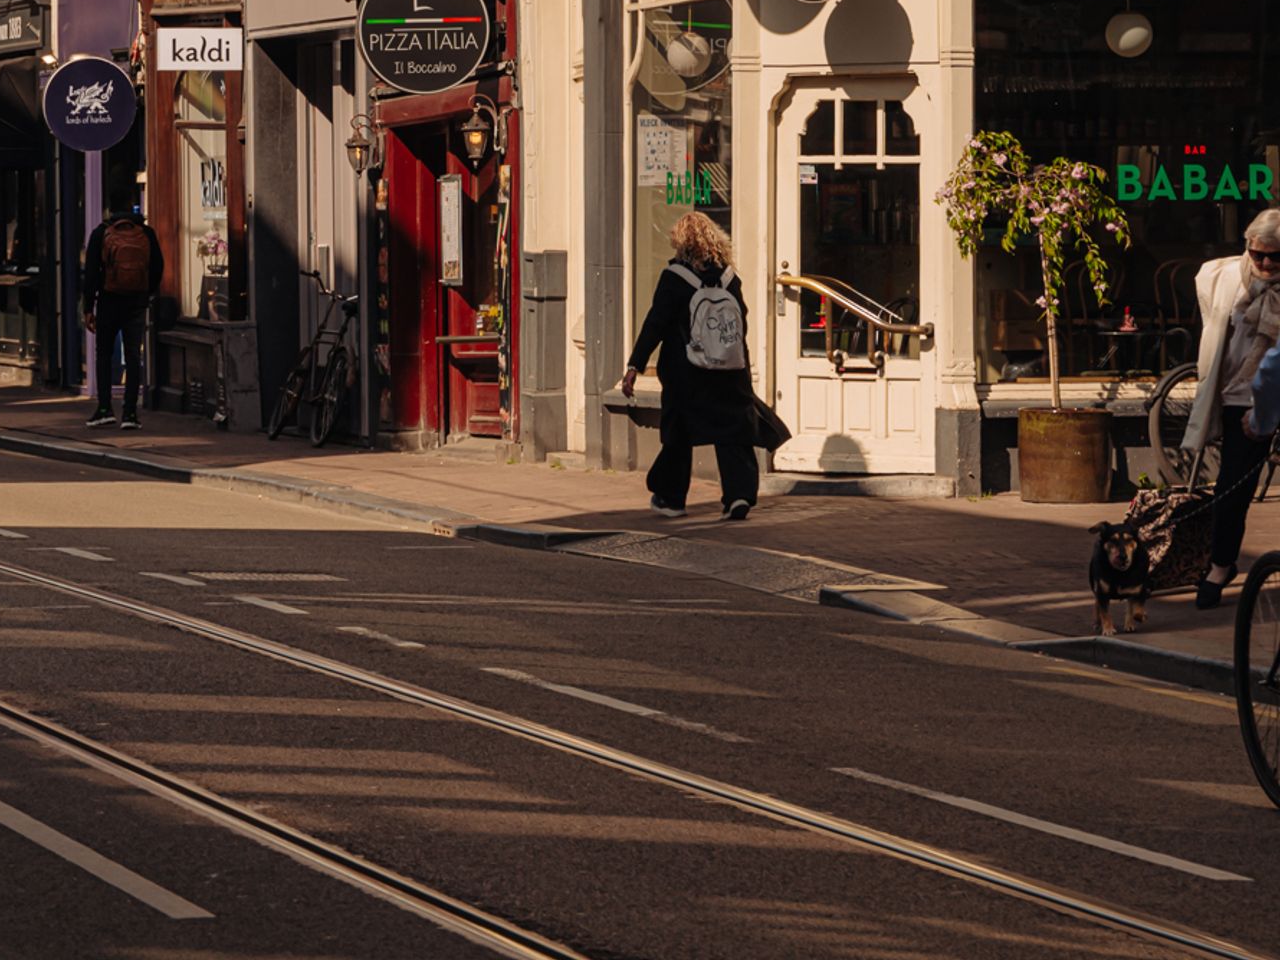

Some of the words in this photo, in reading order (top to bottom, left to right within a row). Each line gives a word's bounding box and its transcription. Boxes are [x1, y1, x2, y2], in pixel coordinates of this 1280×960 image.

[172, 36, 230, 62] kaldi
[369, 32, 423, 52] PIZZA
[426, 29, 479, 51] ITALIA
[394, 62, 404, 74] Il
[407, 61, 458, 74] Boccalino
[1184, 144, 1207, 155] BAR
[666, 169, 711, 205] BABAR
[1116, 164, 1274, 201] BABAR
